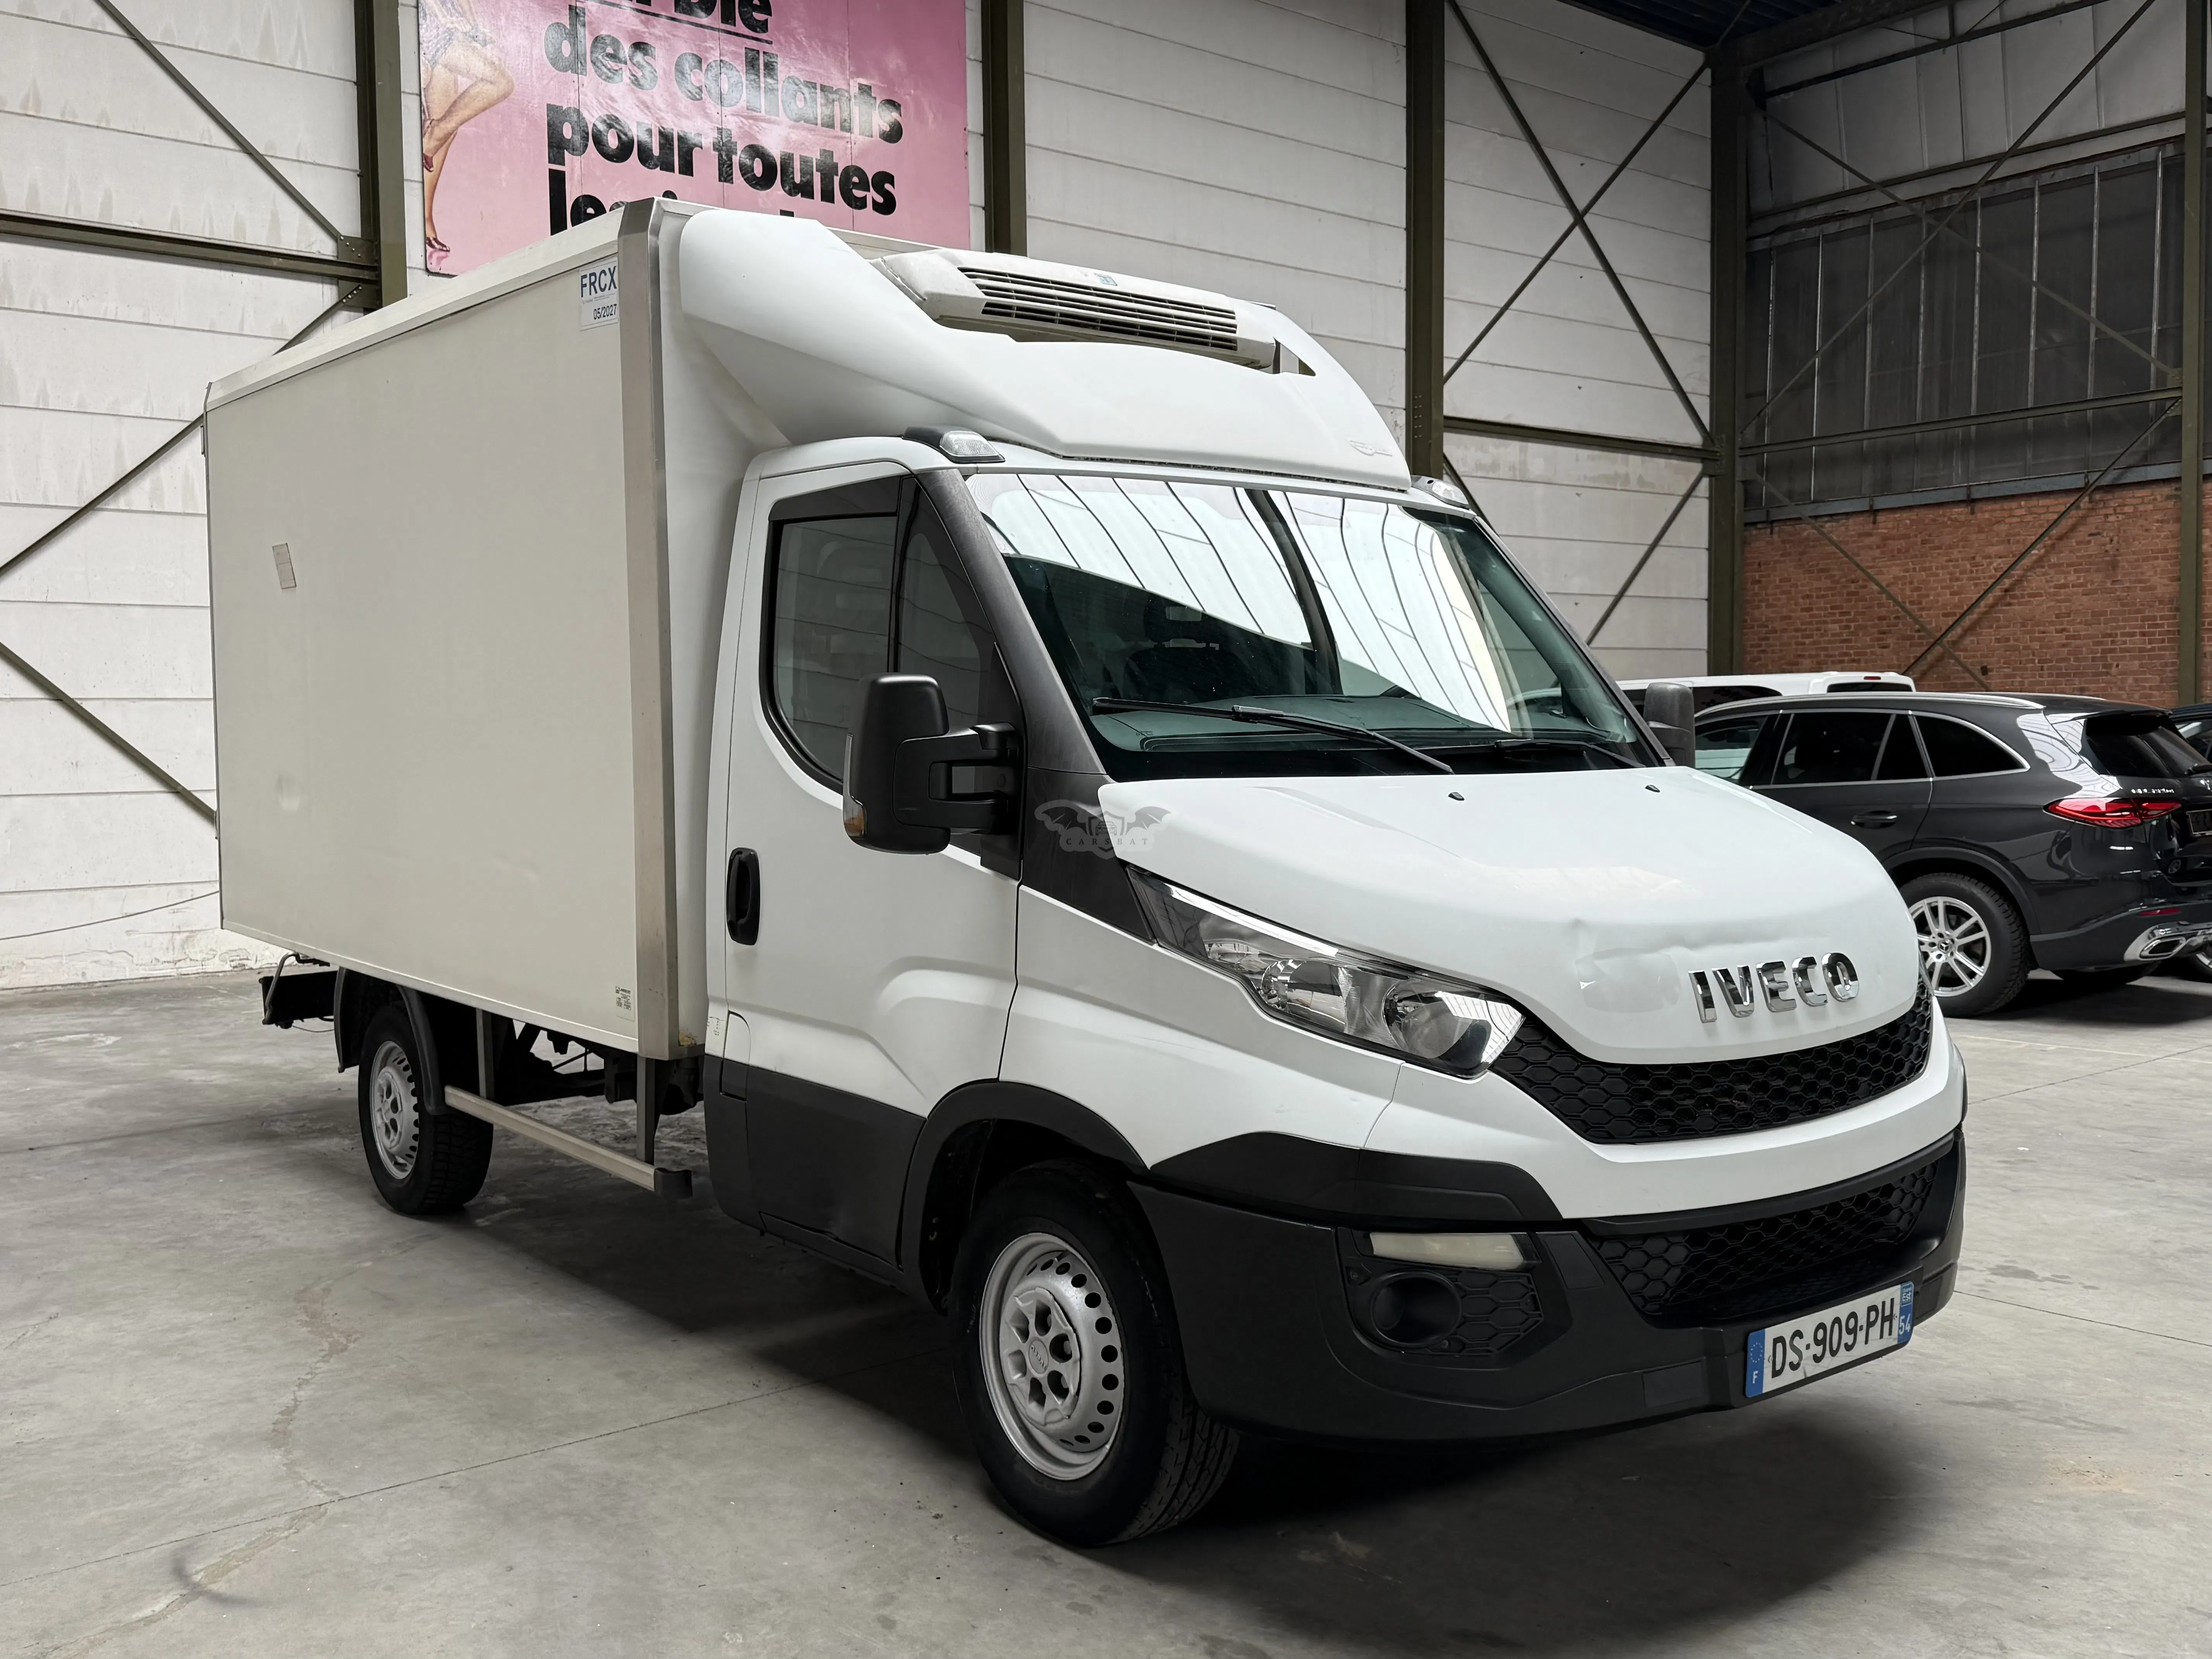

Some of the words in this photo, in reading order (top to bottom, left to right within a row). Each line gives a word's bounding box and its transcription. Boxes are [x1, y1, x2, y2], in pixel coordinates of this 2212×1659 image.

[544, 4, 658, 90] des
[675, 47, 903, 144] collants
[546, 103, 702, 177] pour
[712, 127, 896, 215] toutes
[548, 168, 629, 236] le
[581, 266, 617, 298] FRCX
[593, 304, 617, 320] 05/2027
[1688, 952, 1859, 1023] IVECO
[1752, 1370, 1759, 1384] F
[1899, 1313, 1911, 1334] 54
